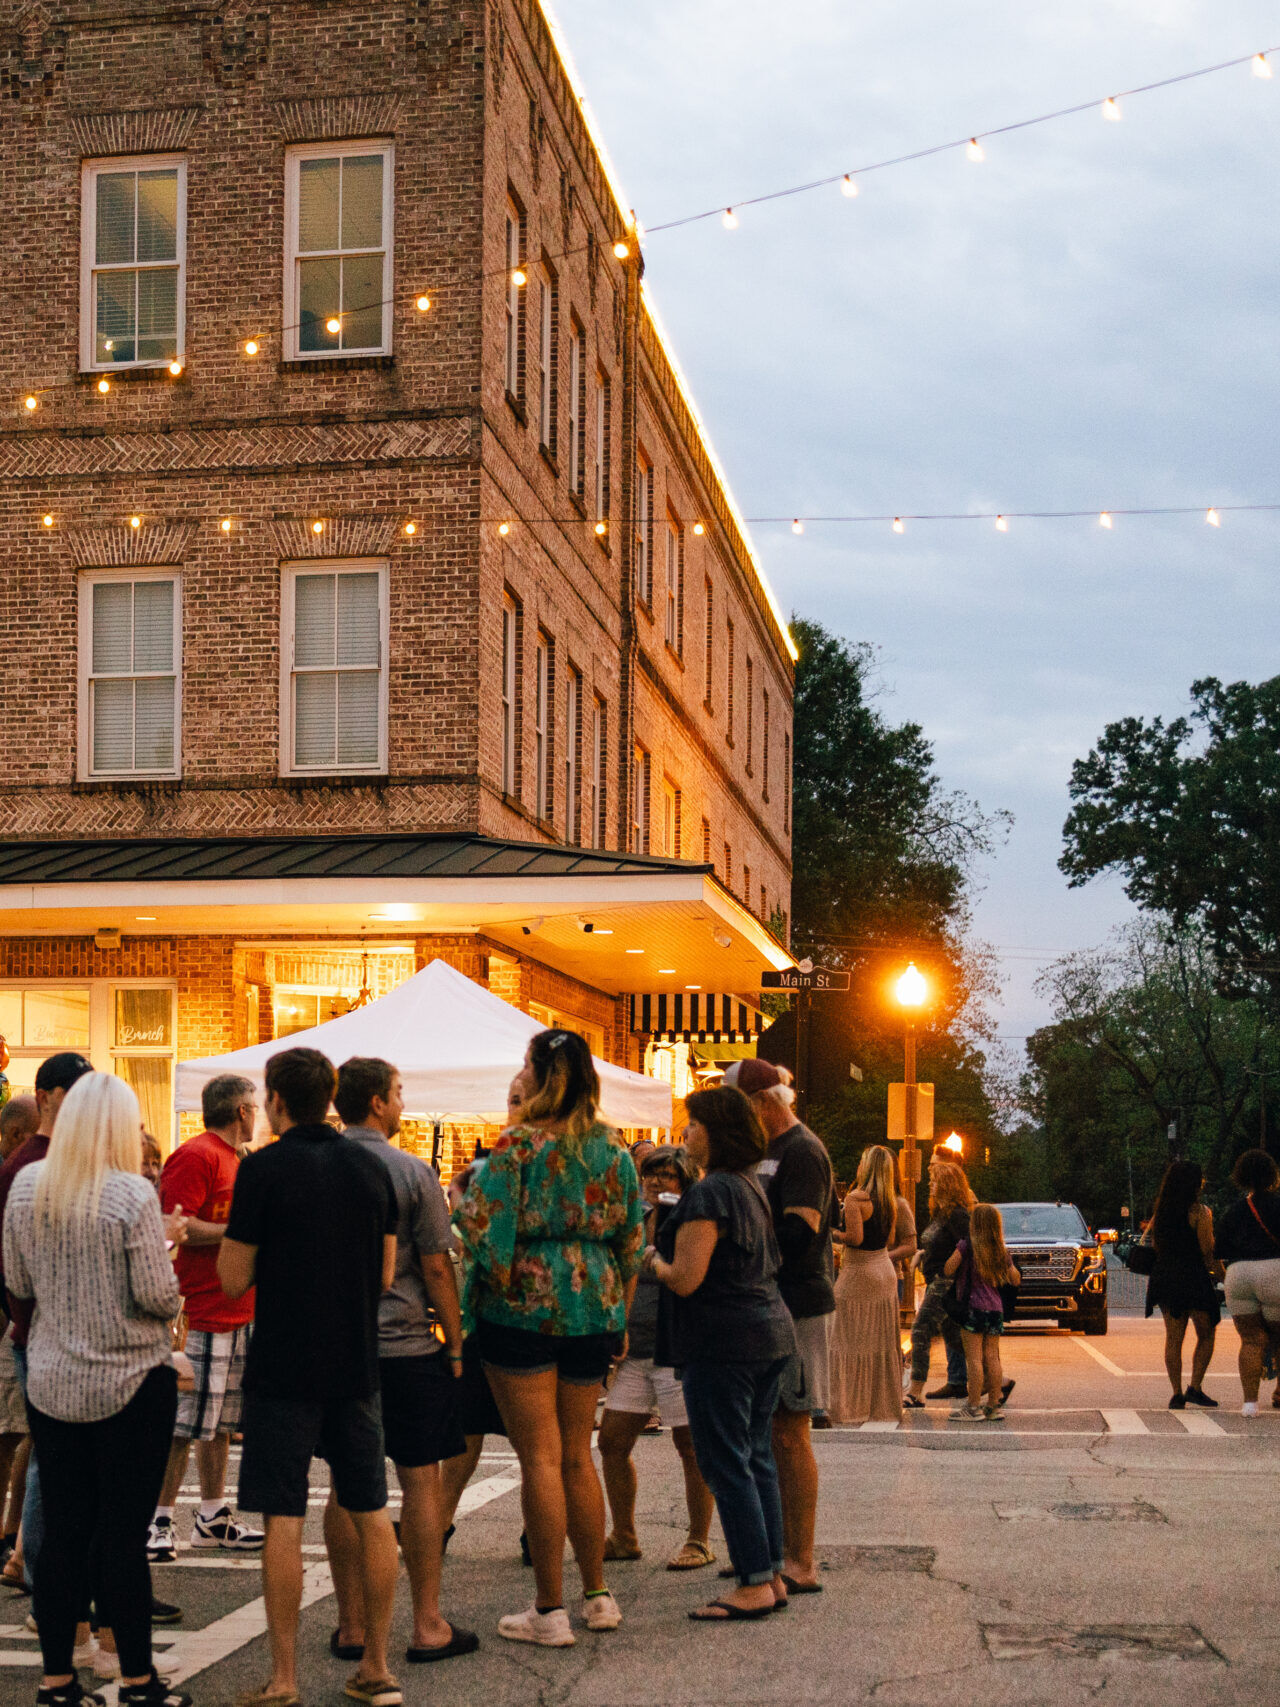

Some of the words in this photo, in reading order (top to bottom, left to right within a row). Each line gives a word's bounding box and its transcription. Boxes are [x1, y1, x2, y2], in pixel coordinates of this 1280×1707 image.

[780, 973, 811, 987] Main
[816, 974, 830, 987] St
[120, 1024, 164, 1043] Brunch
